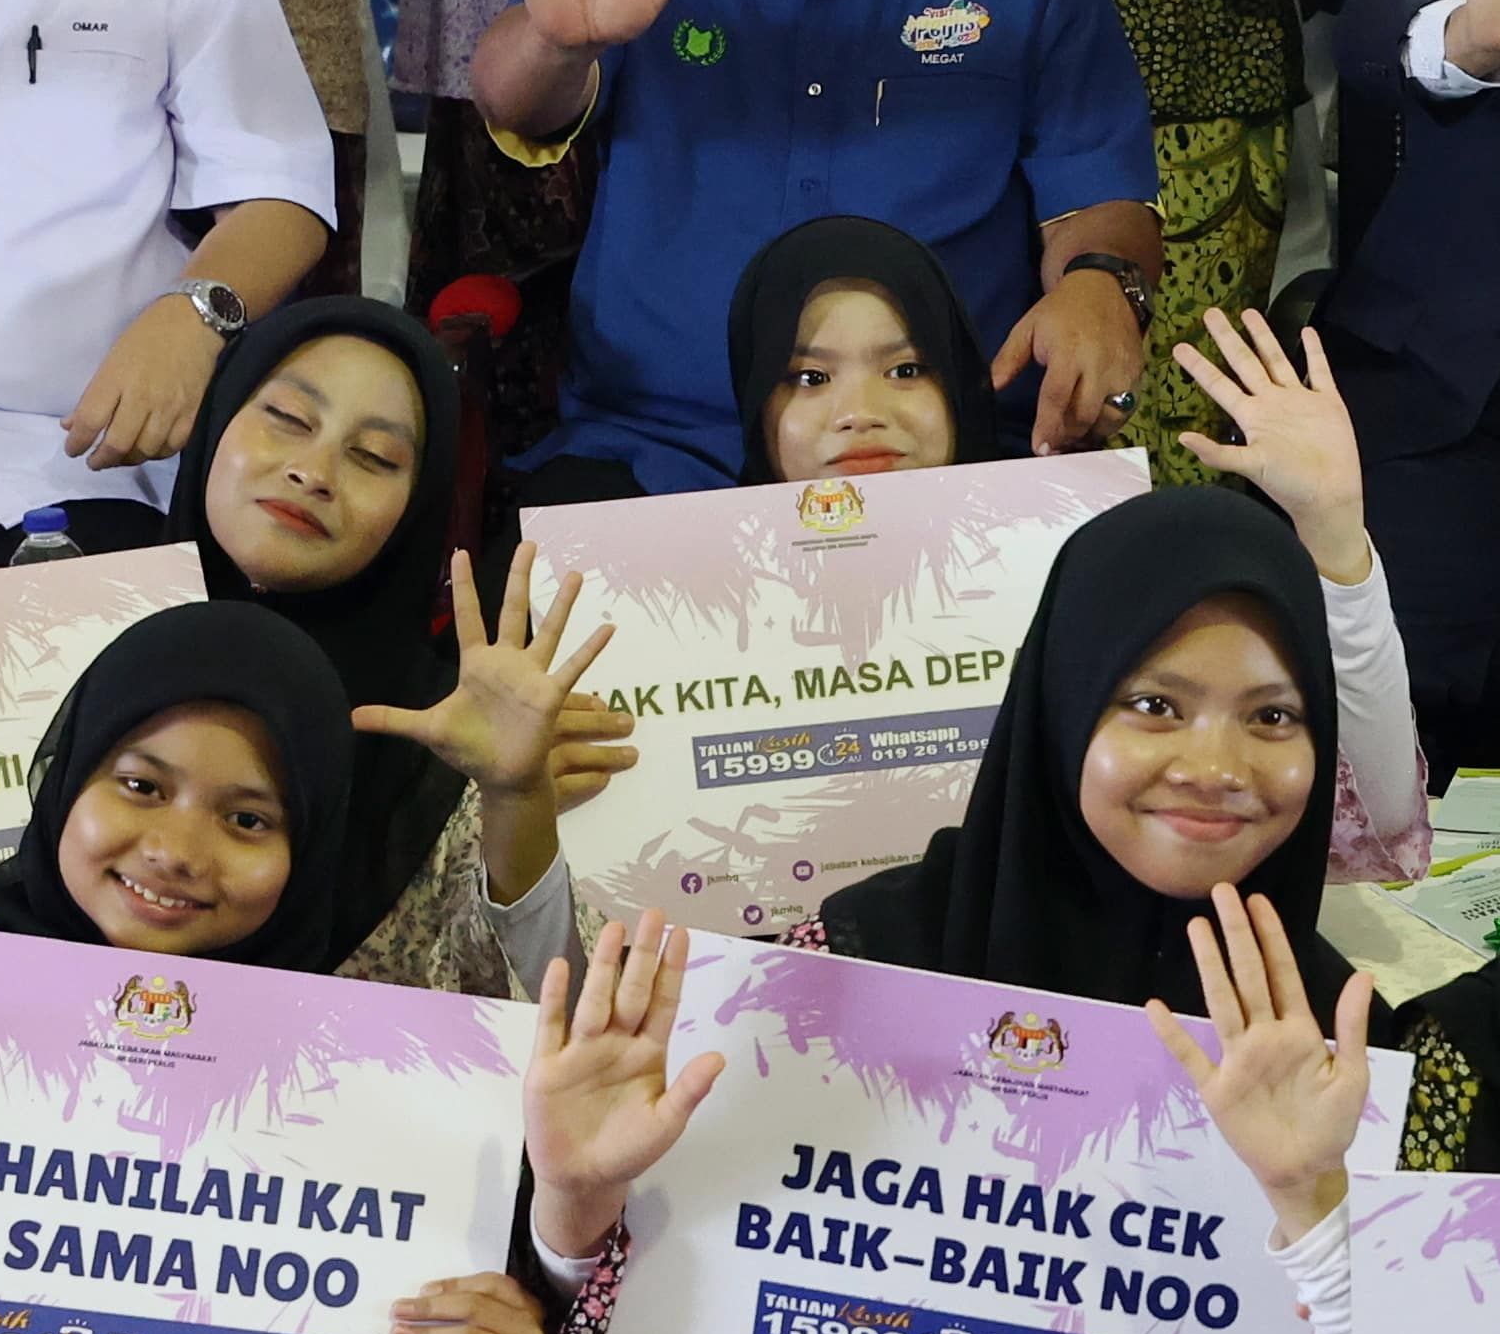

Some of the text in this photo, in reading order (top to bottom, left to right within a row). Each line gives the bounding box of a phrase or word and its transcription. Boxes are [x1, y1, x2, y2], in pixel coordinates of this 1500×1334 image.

[73, 21, 109, 32] OMAR
[921, 52, 965, 65] MEGAT
[676, 673, 782, 718] KITA,
[794, 659, 913, 699] MASA
[698, 740, 755, 758] TALIAN
[868, 724, 961, 750] Whatsapp
[700, 748, 817, 781] 15999
[871, 744, 939, 762] 019 26
[298, 1180, 425, 1242] KAT
[780, 1141, 1225, 1262] JAGA HAK CEK
[2, 1218, 203, 1290] SAMA
[216, 1244, 361, 1309] NOO
[734, 1202, 1241, 1332] BAIK-BAIK NOO
[763, 1292, 837, 1318] TALIAN
